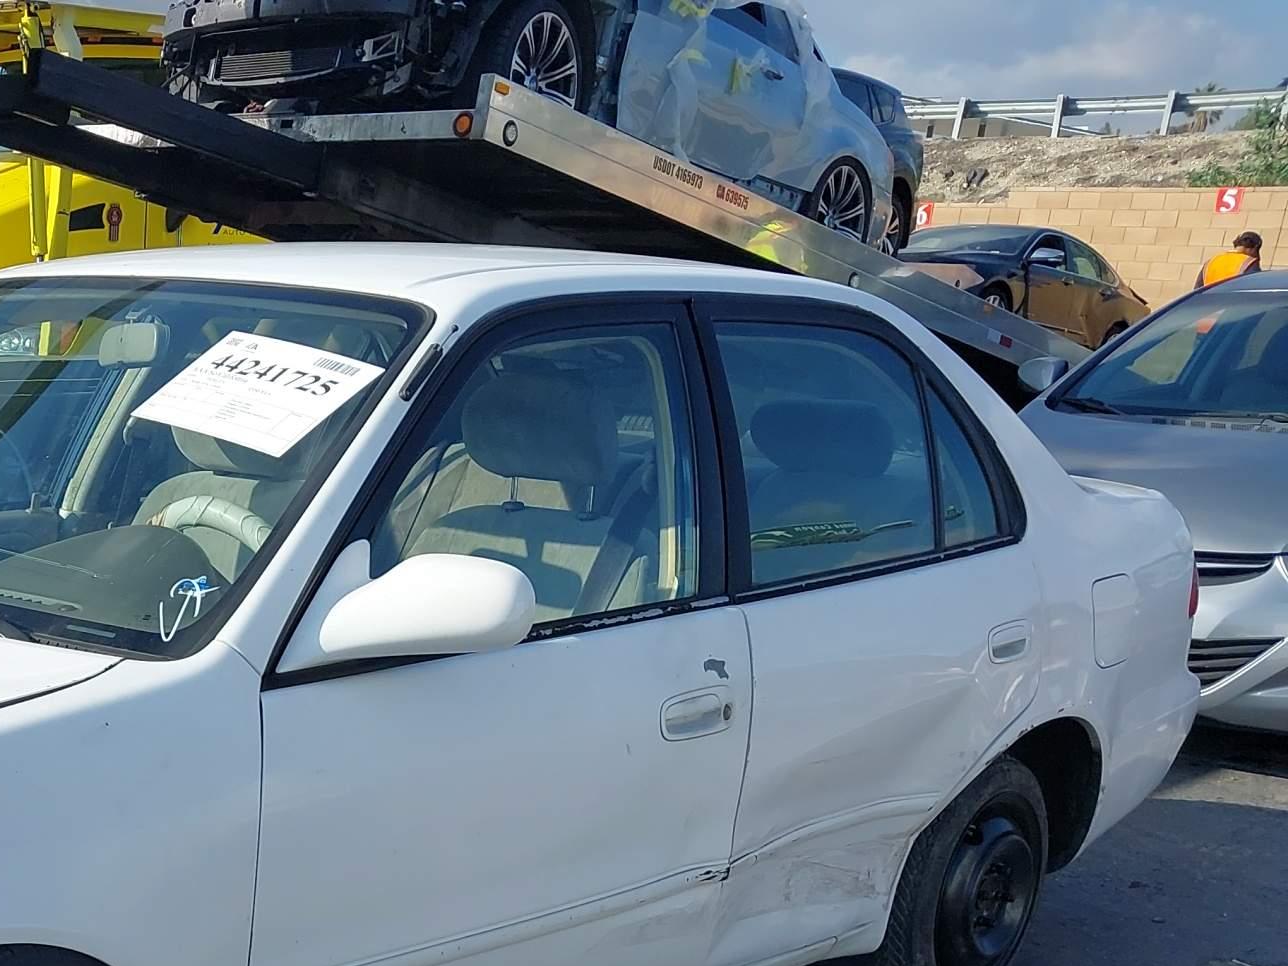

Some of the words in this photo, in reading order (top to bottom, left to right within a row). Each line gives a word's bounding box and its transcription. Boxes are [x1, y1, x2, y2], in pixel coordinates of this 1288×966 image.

[653, 155, 676, 177] USDOT
[1219, 188, 1239, 212] 5
[916, 203, 931, 226] 6
[210, 354, 341, 396] 44241725
